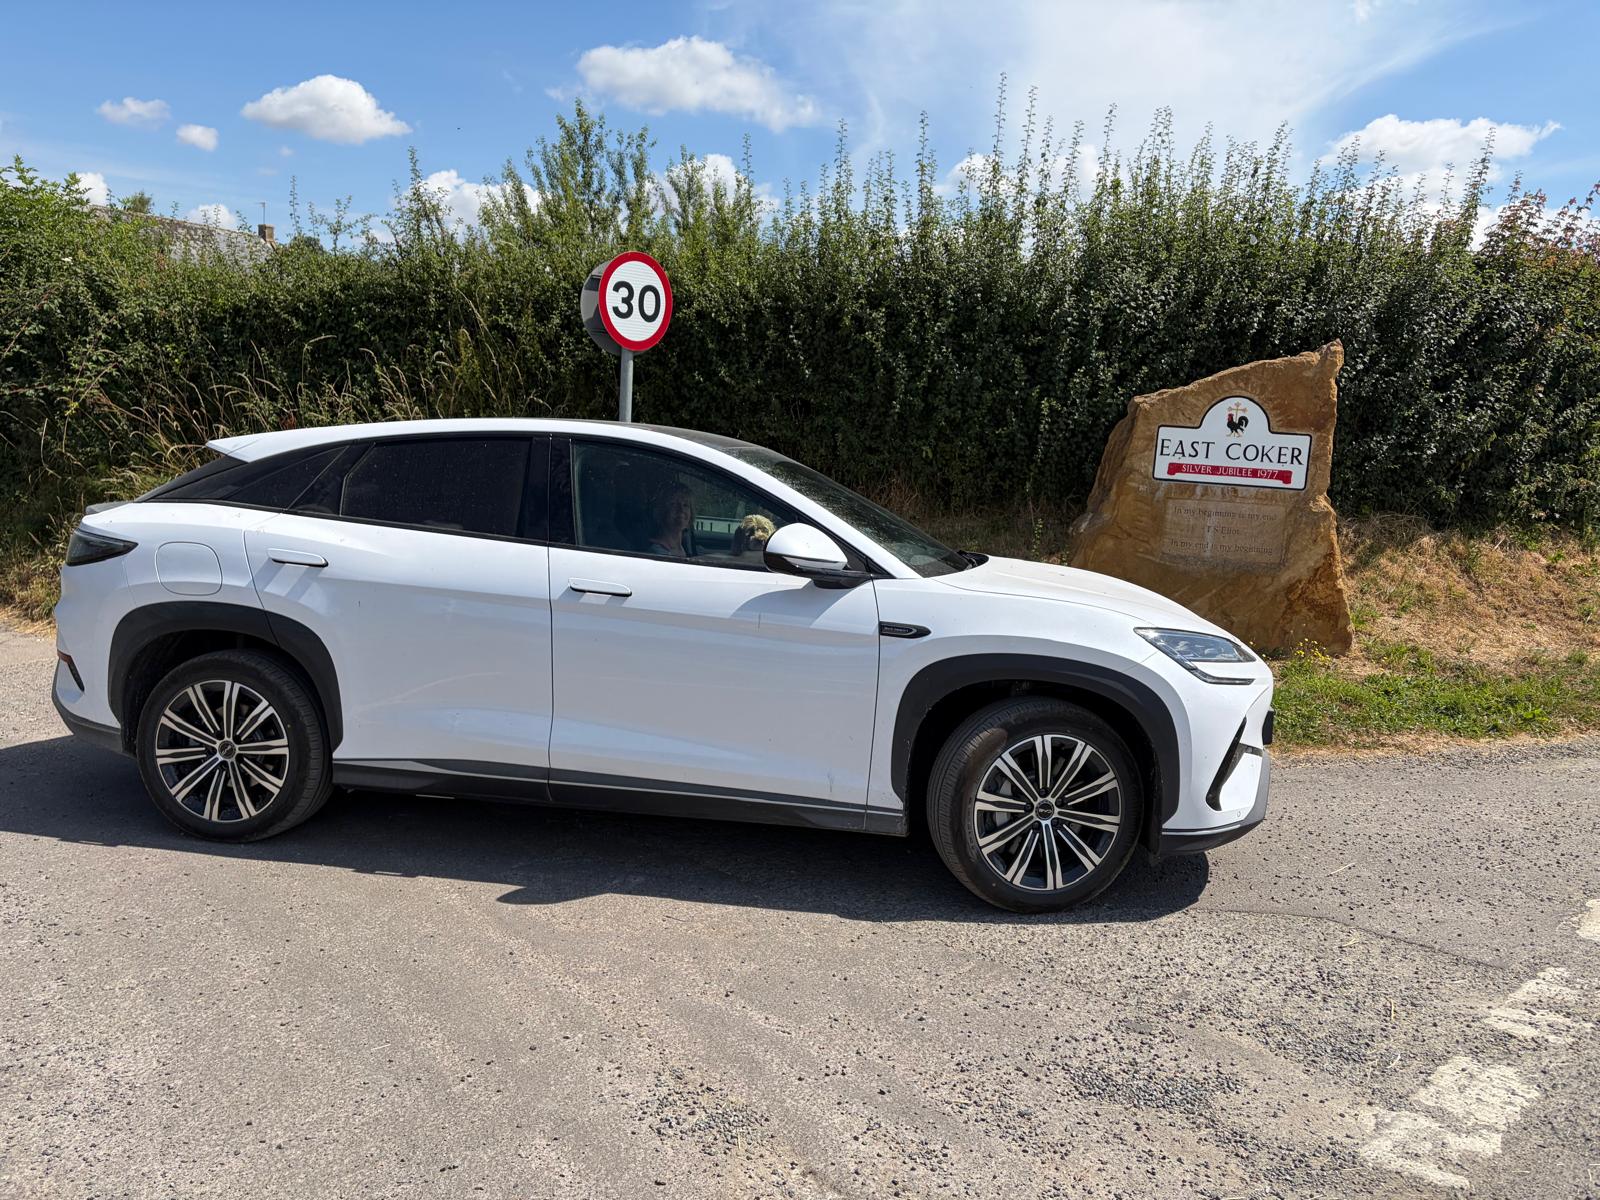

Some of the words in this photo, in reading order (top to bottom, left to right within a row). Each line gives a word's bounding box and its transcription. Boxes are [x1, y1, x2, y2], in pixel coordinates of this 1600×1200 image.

[612, 280, 661, 323] 30
[1159, 438, 1216, 459] EAST
[1226, 442, 1304, 465] COKER
[1181, 464, 1212, 474] SILVER
[1217, 466, 1253, 476] JUBILEE
[1257, 468, 1279, 479] 1977
[1184, 508, 1196, 516] my
[1198, 507, 1237, 519] beginning
[1180, 540, 1192, 549] my
[1194, 540, 1209, 549] end
[1219, 543, 1233, 552] my
[1234, 543, 1273, 555] beginning
